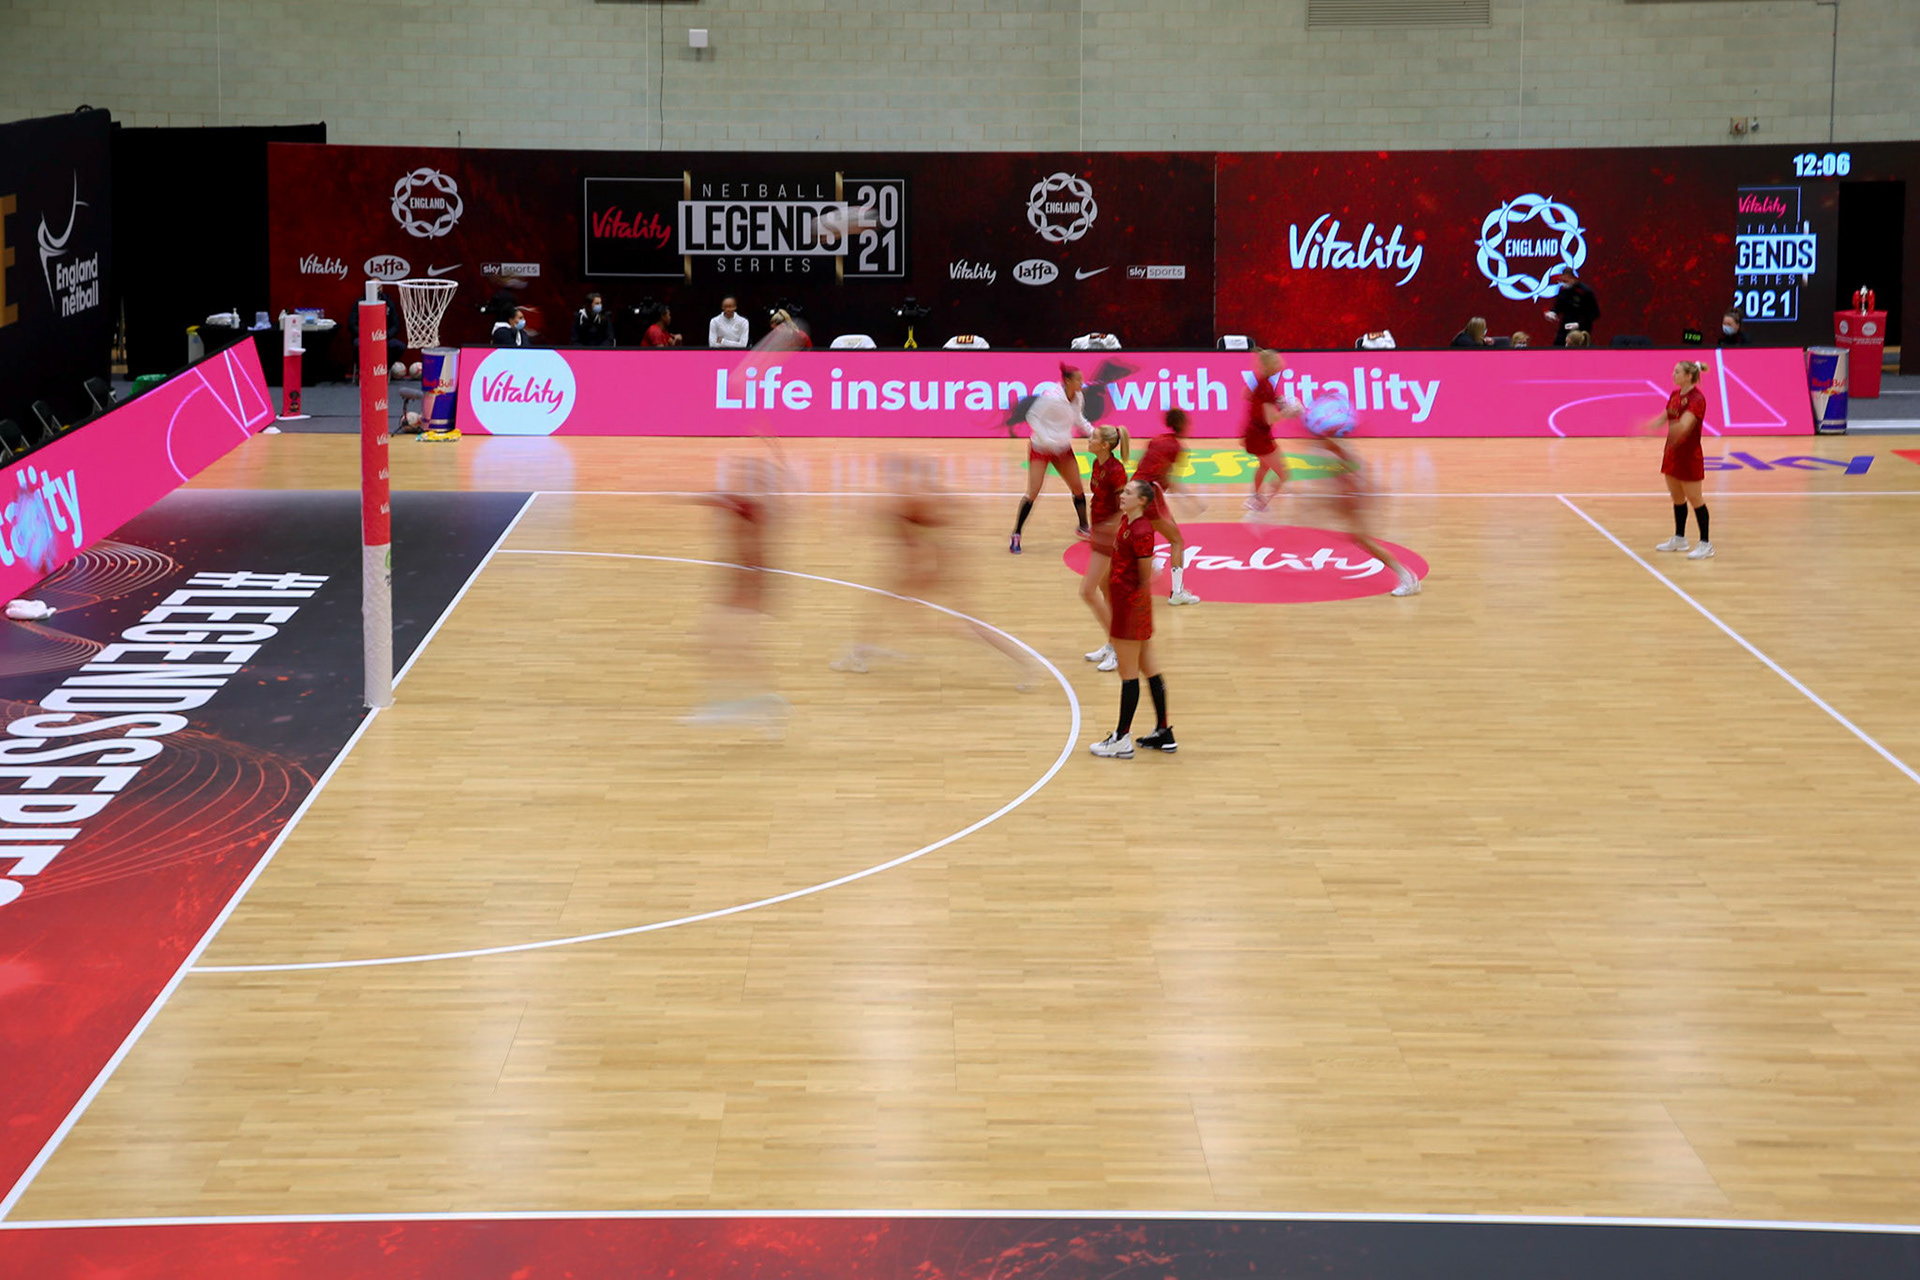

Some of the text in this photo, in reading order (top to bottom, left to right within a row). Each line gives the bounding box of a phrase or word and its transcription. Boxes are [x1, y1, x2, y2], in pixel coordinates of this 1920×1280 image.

[1792, 152, 1851, 177] 12:06
[409, 197, 446, 210] ENGLAND
[702, 183, 825, 198] NETBALL
[857, 185, 899, 228] 20
[1044, 201, 1081, 214] ENGLAND
[1738, 193, 1787, 218] Vitality
[592, 205, 672, 250] Vitality
[684, 204, 844, 252] LEGENDS
[858, 229, 897, 273] 21
[1288, 212, 1424, 287] Vitality
[1504, 238, 1559, 258] ENGLAND
[1736, 239, 1814, 270] GENDS
[55, 251, 99, 294] England
[299, 253, 348, 281] Vitality
[482, 263, 500, 276] sky
[717, 257, 812, 273] SERIES
[949, 258, 997, 287] Vitality
[1128, 266, 1184, 279] sky sports
[61, 280, 99, 318] netball
[481, 370, 565, 415] Vitality
[715, 366, 813, 410] Life
[1106, 367, 1228, 412] with
